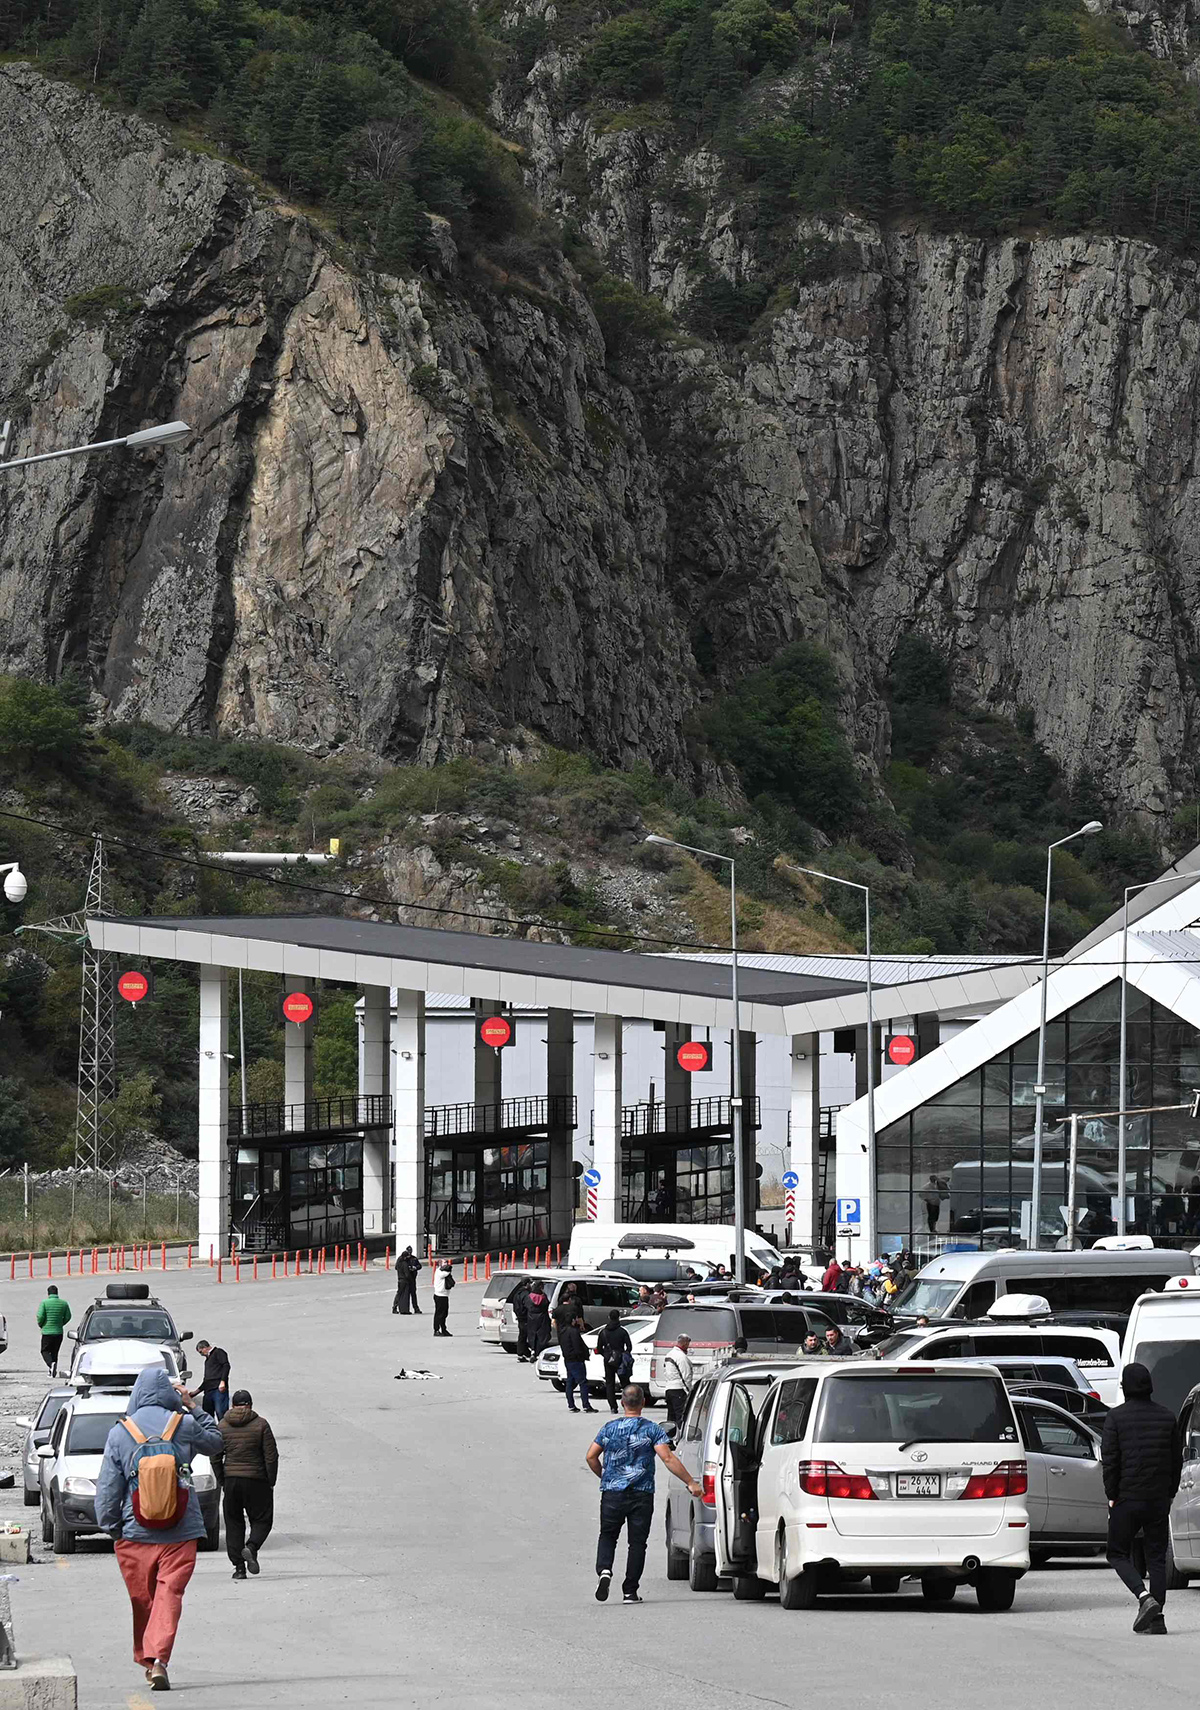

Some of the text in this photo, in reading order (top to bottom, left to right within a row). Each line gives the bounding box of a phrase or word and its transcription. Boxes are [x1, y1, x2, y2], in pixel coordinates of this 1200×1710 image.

[841, 1200, 857, 1222] P
[911, 1476, 937, 1485] 26 XX
[916, 1486, 931, 1494] 444
